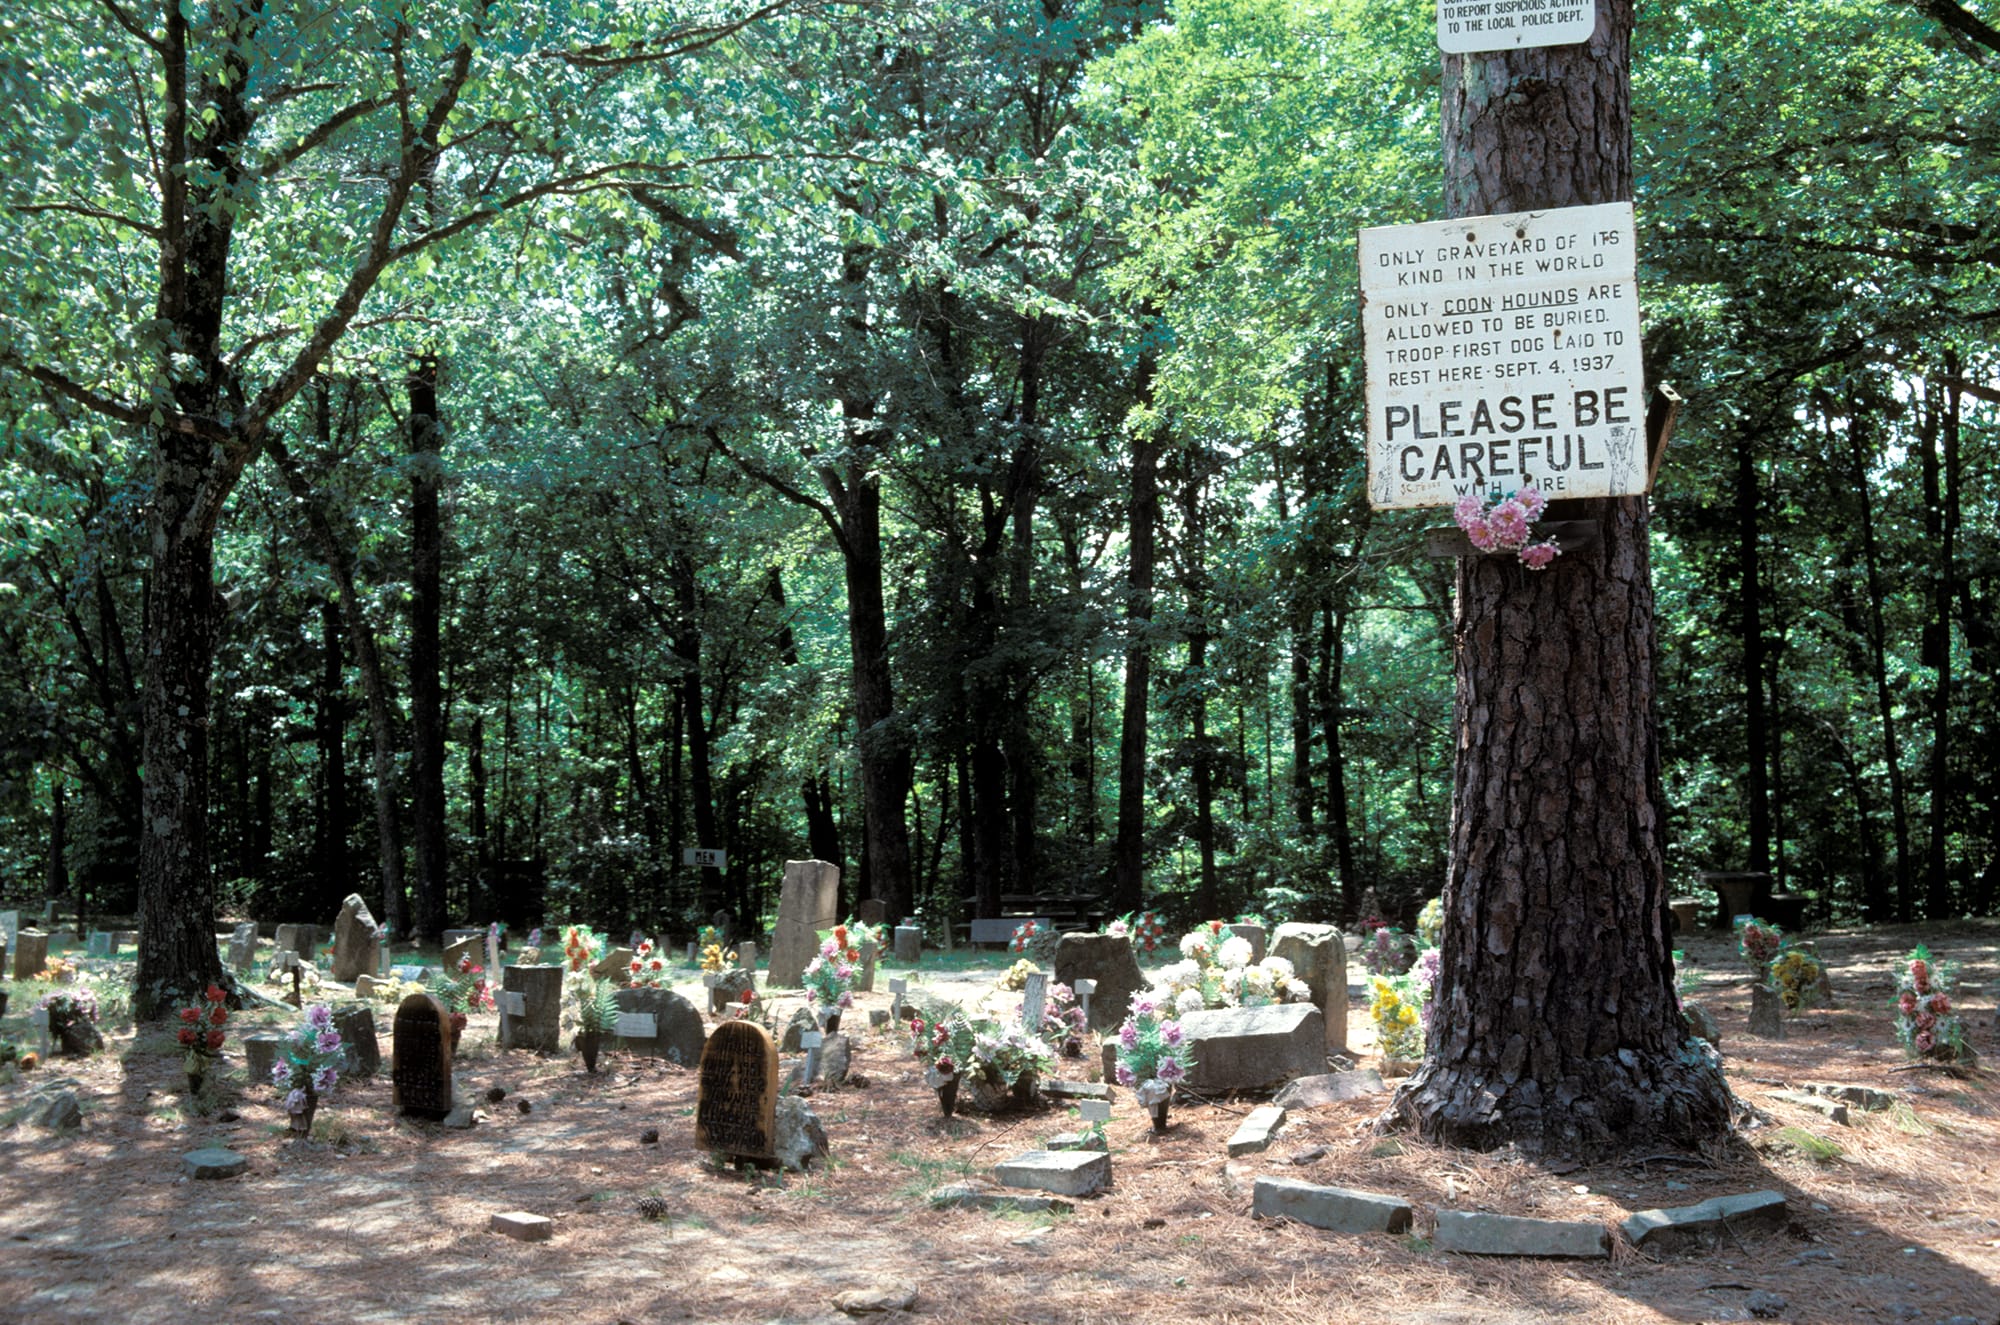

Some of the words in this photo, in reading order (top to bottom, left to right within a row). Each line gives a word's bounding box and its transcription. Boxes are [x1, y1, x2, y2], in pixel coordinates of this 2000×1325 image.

[1443, 8, 1455, 19] TO
[1457, 4, 1491, 18] REPORT
[1495, 0, 1546, 14] SUSPICIOUS
[1448, 22, 1460, 34] TO
[1465, 20, 1484, 32] THE
[1488, 17, 1516, 30] LOCAL
[1522, 12, 1554, 26] POLICE
[1557, 10, 1584, 23] DEPT.
[1380, 250, 1424, 268] ONLY
[1437, 238, 1546, 262] GRAVEYARD
[1556, 235, 1578, 250] OF
[1398, 269, 1443, 286] KIND
[1458, 266, 1476, 280] IN
[1489, 261, 1525, 278] THE
[1535, 254, 1605, 273] WORLD
[1384, 302, 1429, 319] ONLY
[1444, 296, 1492, 314] COON
[1502, 288, 1579, 310] HOUNDS
[1588, 284, 1622, 300] ARE
[1386, 321, 1474, 341] ALLOWED
[1482, 318, 1503, 333] TO
[1515, 314, 1536, 330] BE
[1544, 308, 1610, 328] BURIED.
[1512, 338, 1544, 354] DOG
[1554, 333, 1595, 351] LAID
[1604, 330, 1624, 347] TO
[1388, 370, 1430, 387] REST
[1573, 354, 1615, 372] 1937
[1385, 393, 1558, 441] PLEASE
[1574, 386, 1630, 428] BE
[1400, 434, 1604, 482] CAREFUL
[1453, 481, 1502, 497] WITH
[695, 851, 715, 863] MEN
